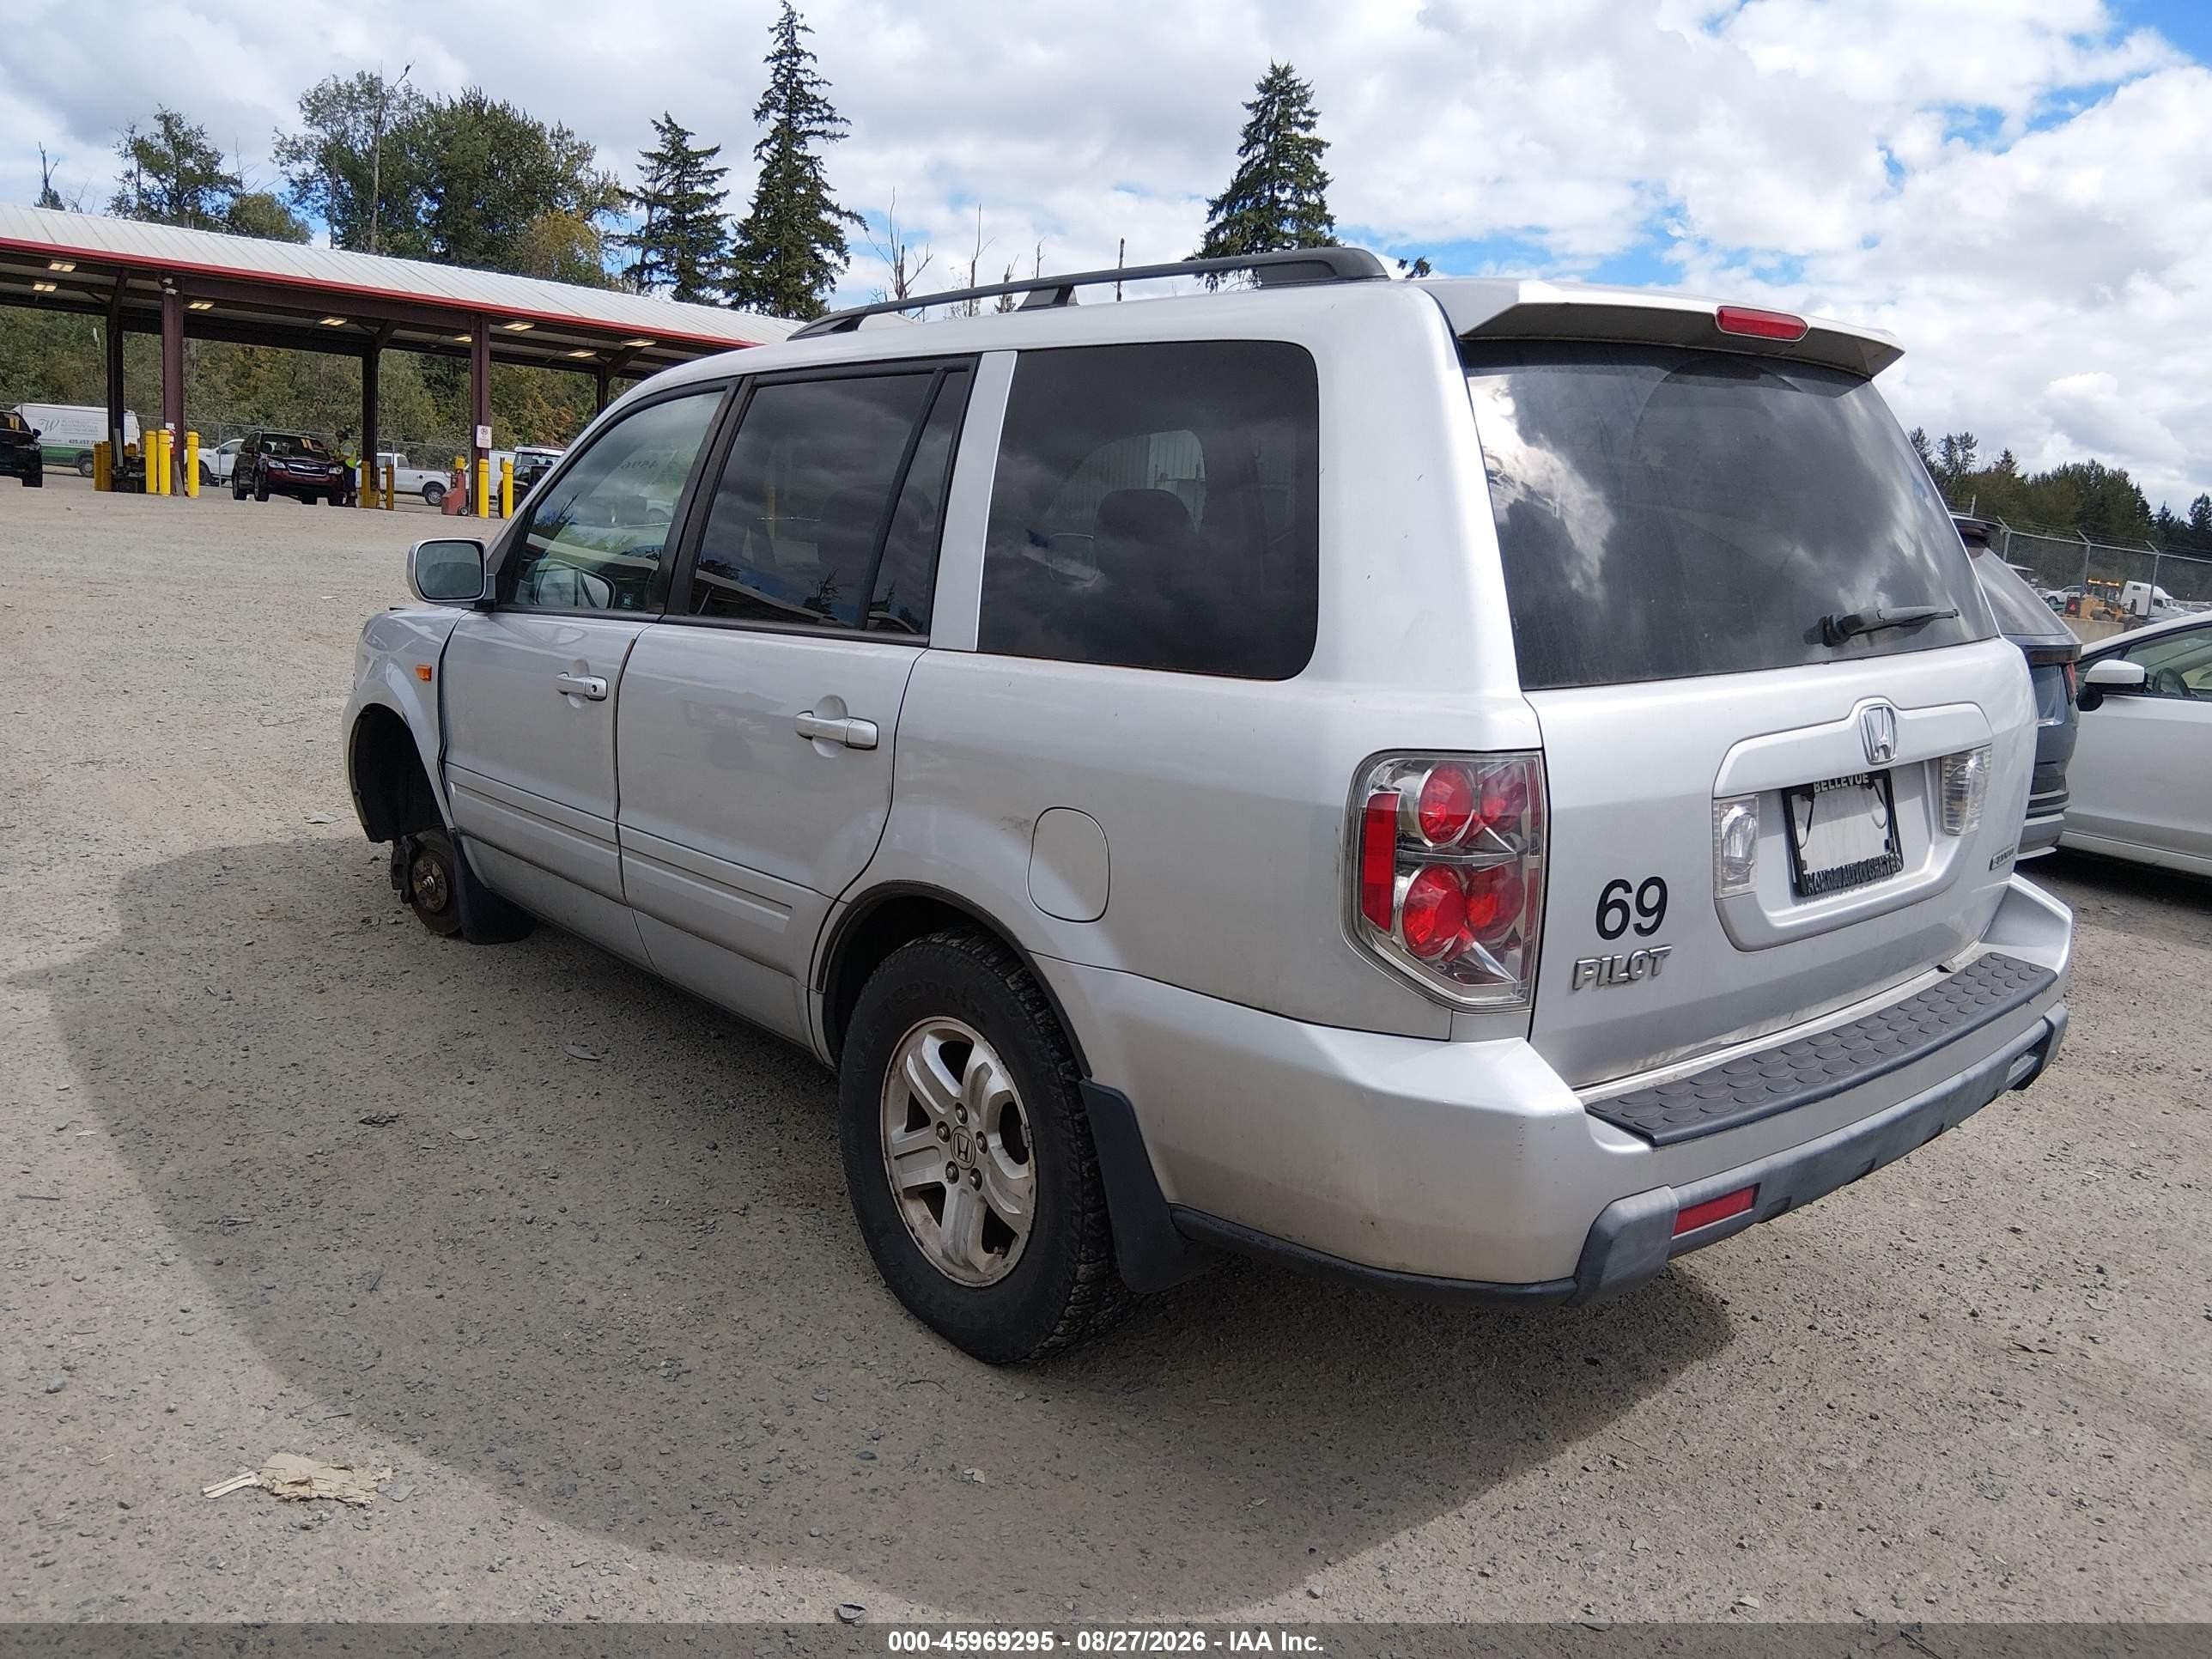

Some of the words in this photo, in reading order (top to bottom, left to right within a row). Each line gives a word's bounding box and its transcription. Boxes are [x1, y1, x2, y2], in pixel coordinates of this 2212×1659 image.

[1813, 774, 1869, 794] BELLEVUE
[1595, 876, 1668, 940] 69
[1572, 945, 1673, 990] PILOT
